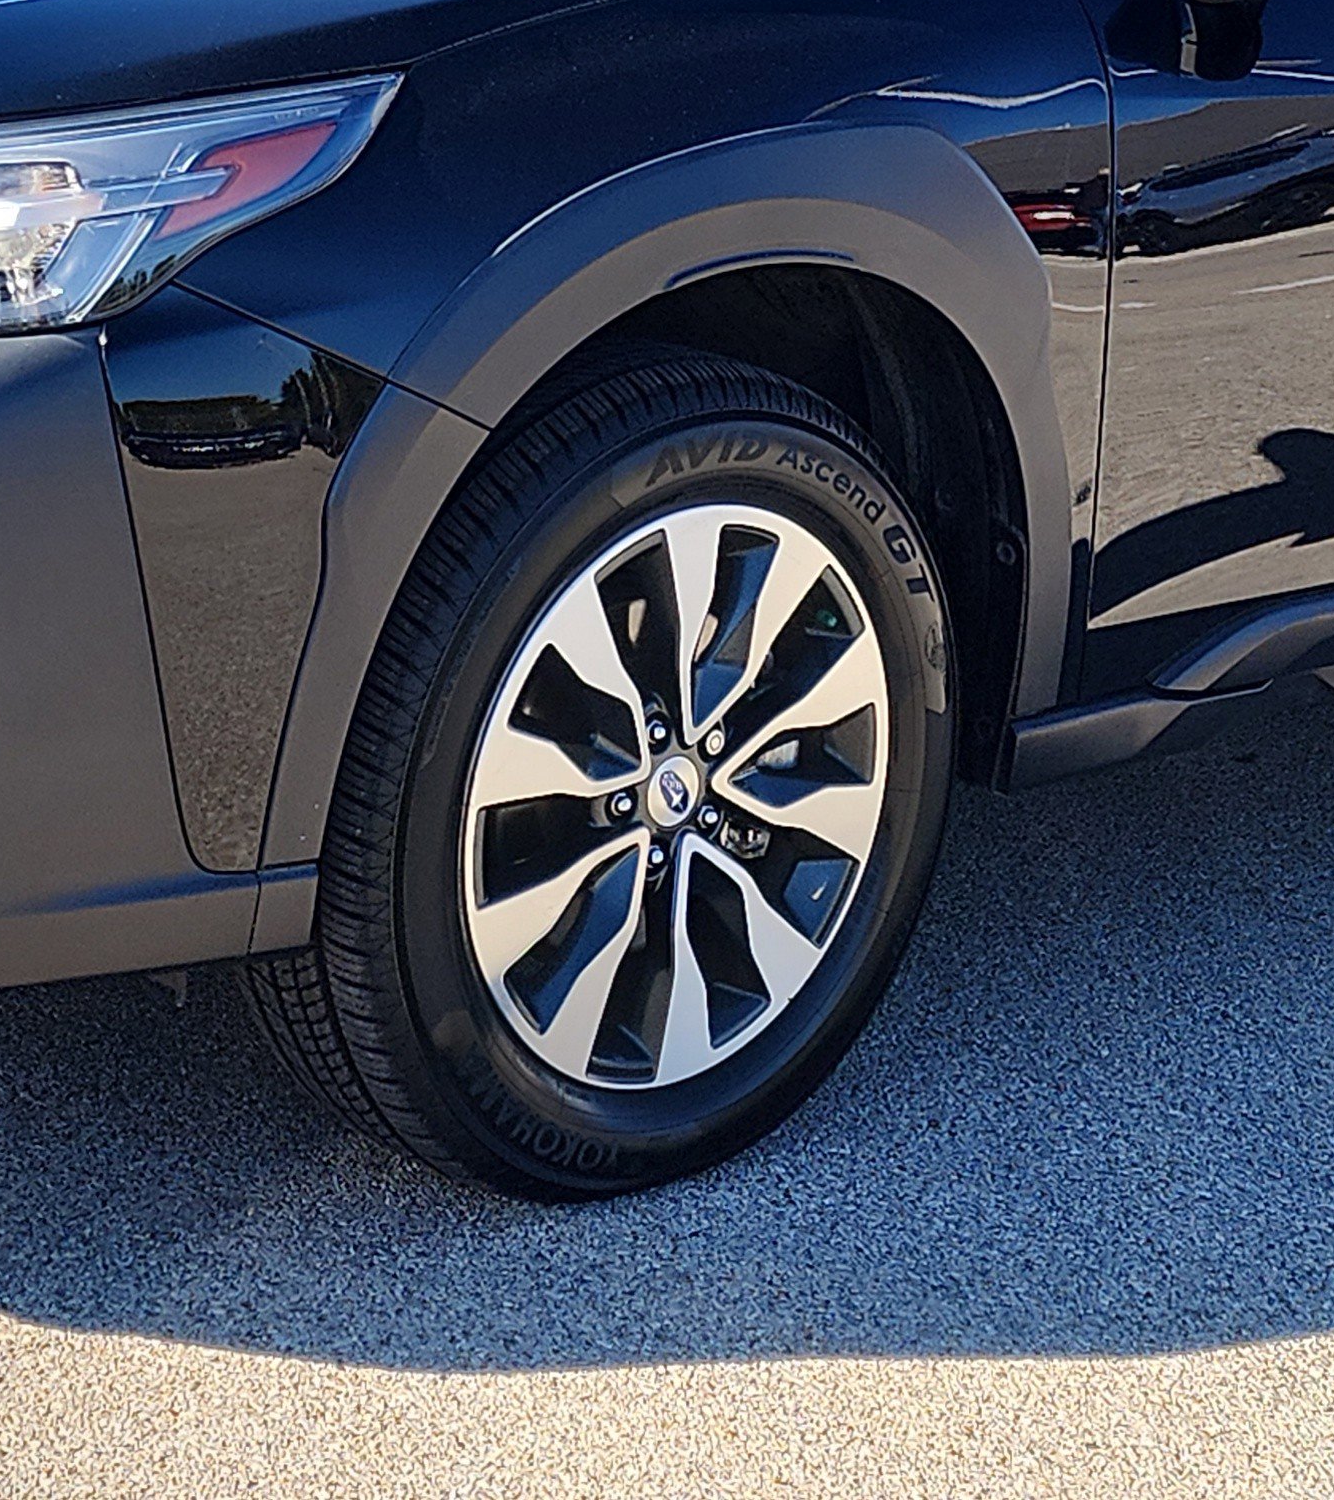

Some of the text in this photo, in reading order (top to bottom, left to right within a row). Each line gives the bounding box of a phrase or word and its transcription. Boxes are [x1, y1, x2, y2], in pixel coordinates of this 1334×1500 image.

[645, 437, 936, 602] AVID Ascend GT
